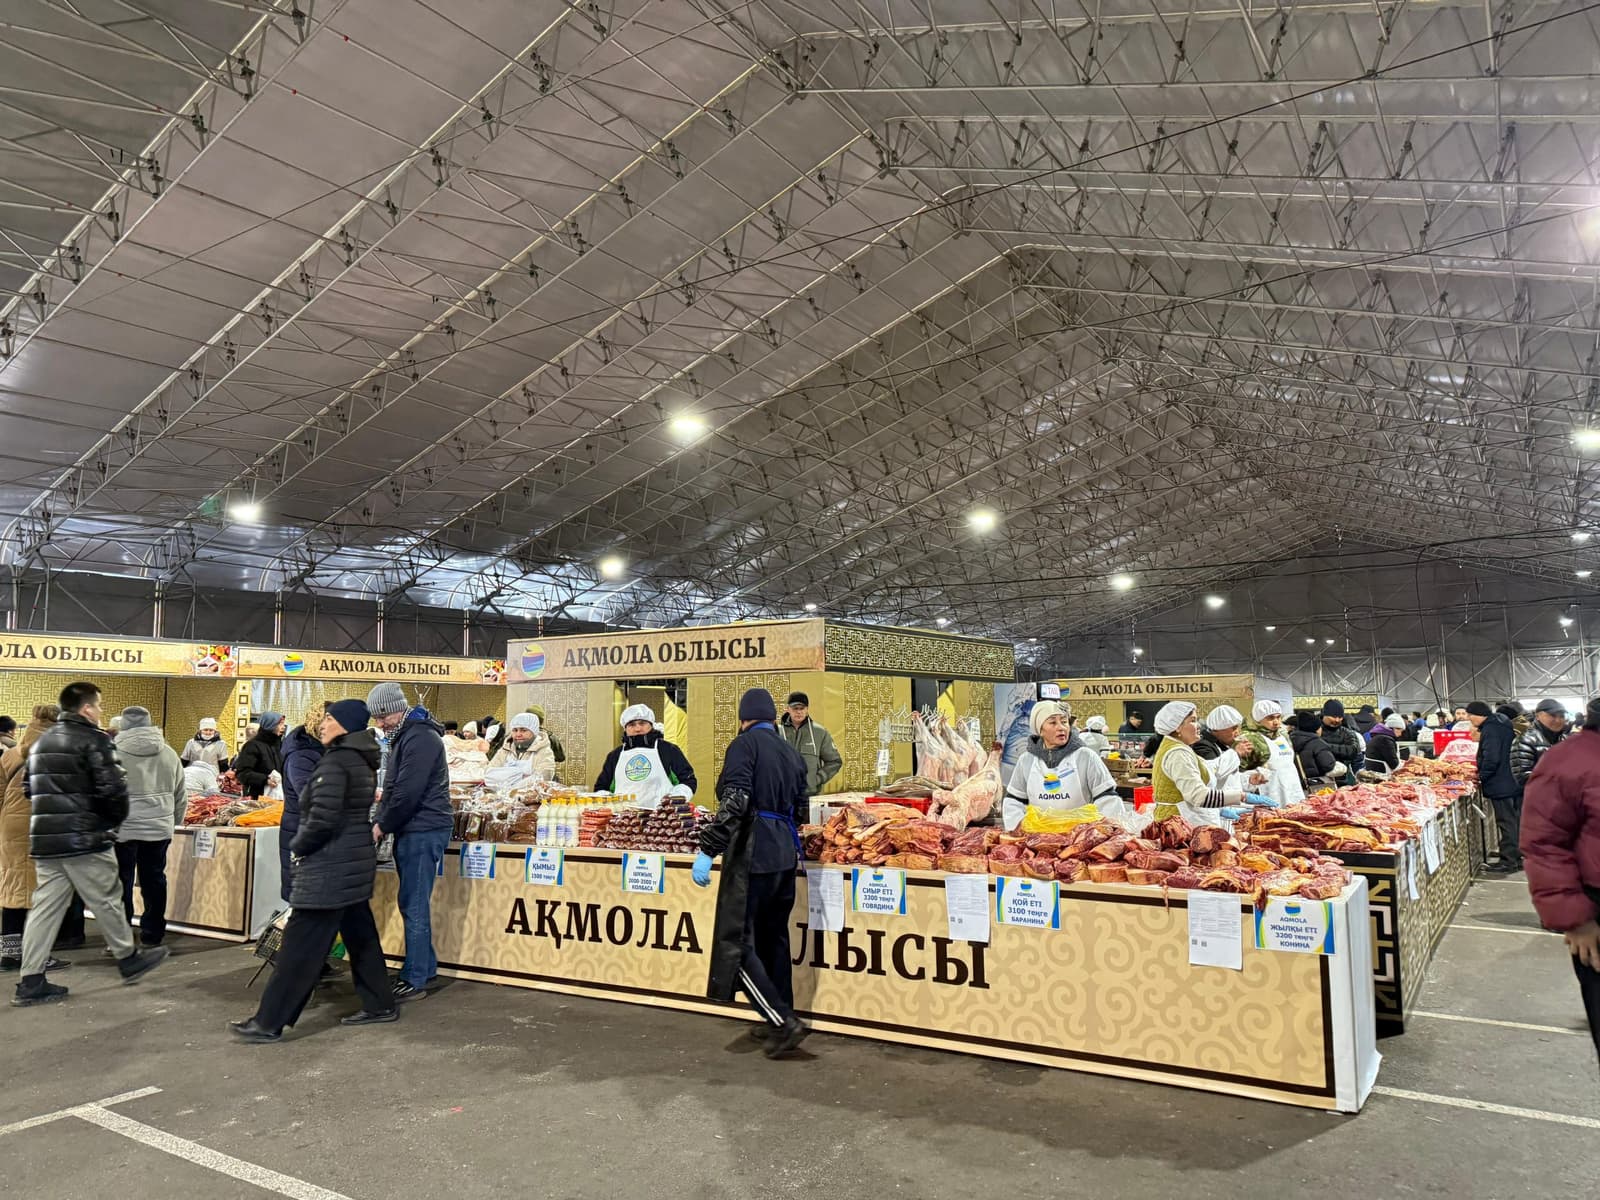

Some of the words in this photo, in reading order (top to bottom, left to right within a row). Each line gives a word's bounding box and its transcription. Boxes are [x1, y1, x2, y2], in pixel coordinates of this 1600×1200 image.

[0, 643, 37, 659] ЛА
[43, 645, 143, 663] ОБЛЫСЫ
[563, 644, 653, 671] АҚМОЛА
[658, 637, 766, 662] ОБЛЫСЫ
[319, 658, 385, 674] АҚМОЛА
[388, 662, 450, 675] ОБЛЫСЫ
[1083, 684, 1143, 696] АҚМОЛА
[1146, 682, 1213, 694] ОБЛЫСЫ
[862, 902, 894, 910] ГОВЯДИНА
[1012, 898, 1028, 906] ҚОЙ
[1008, 906, 1026, 914] 3100
[1012, 916, 1044, 924] БАРАНИНА
[1270, 924, 1302, 933] ЖЫЛҚЫ
[504, 897, 703, 954] АҚМОЛА
[792, 922, 990, 989] ЛЫСЫ
[1280, 940, 1310, 948] КОНИНА
